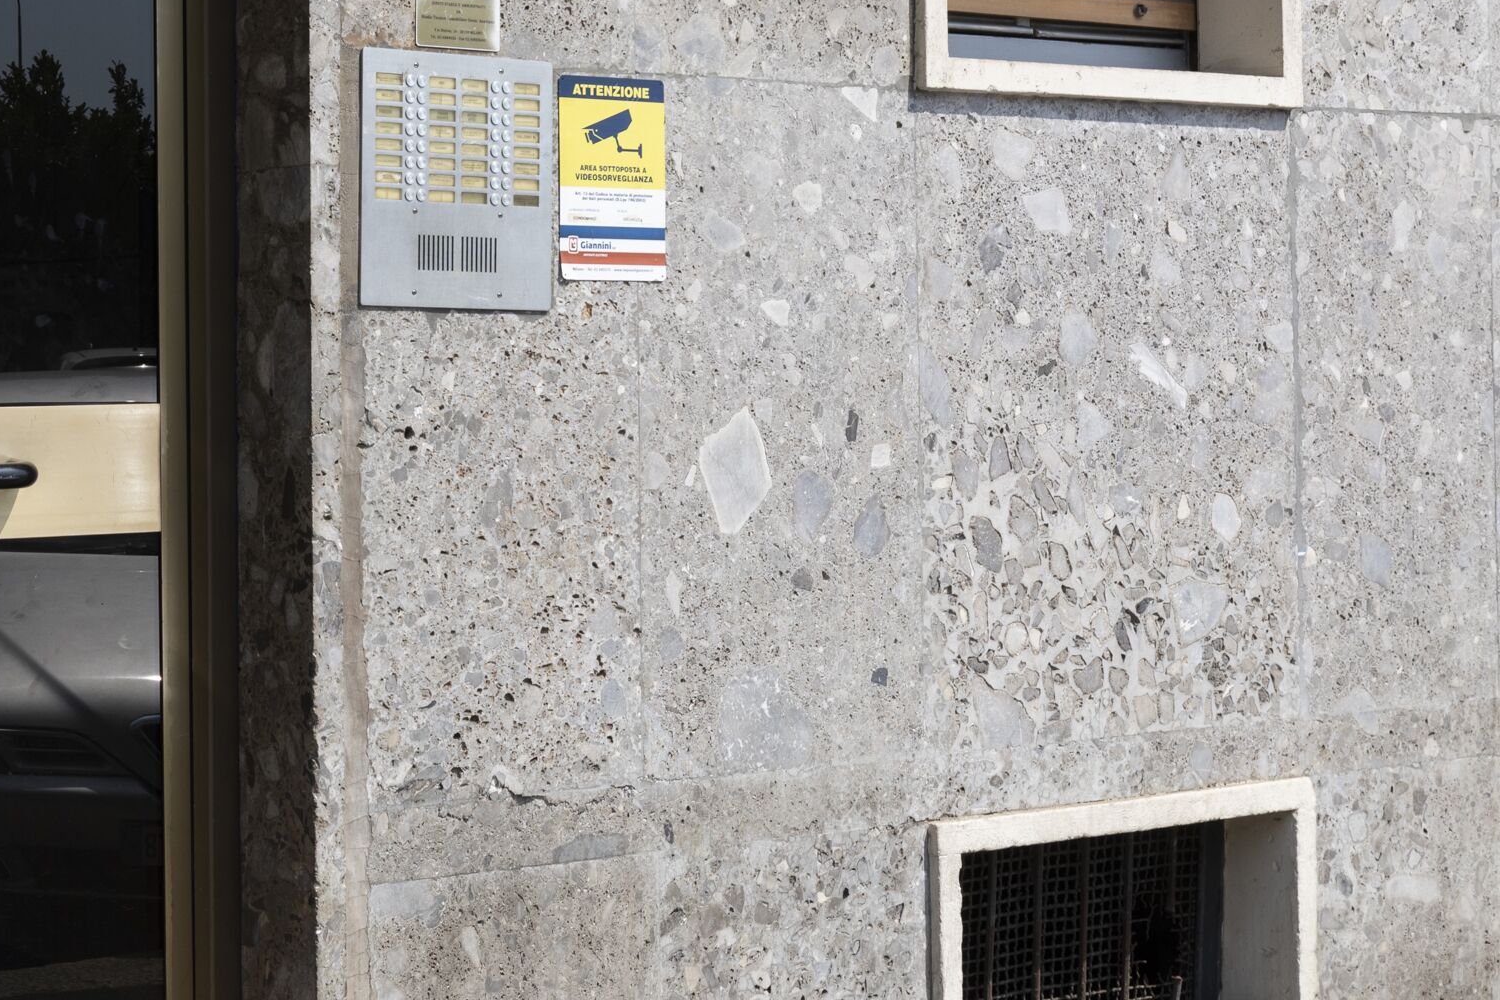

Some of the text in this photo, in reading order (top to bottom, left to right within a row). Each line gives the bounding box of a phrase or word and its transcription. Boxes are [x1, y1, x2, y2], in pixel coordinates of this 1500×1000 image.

[572, 83, 650, 99] ATTENZIONE
[599, 165, 641, 173] SOTTOPOSTA
[575, 173, 654, 183] VIDEOSORVEGLIANZA
[580, 241, 612, 250] Giannini
